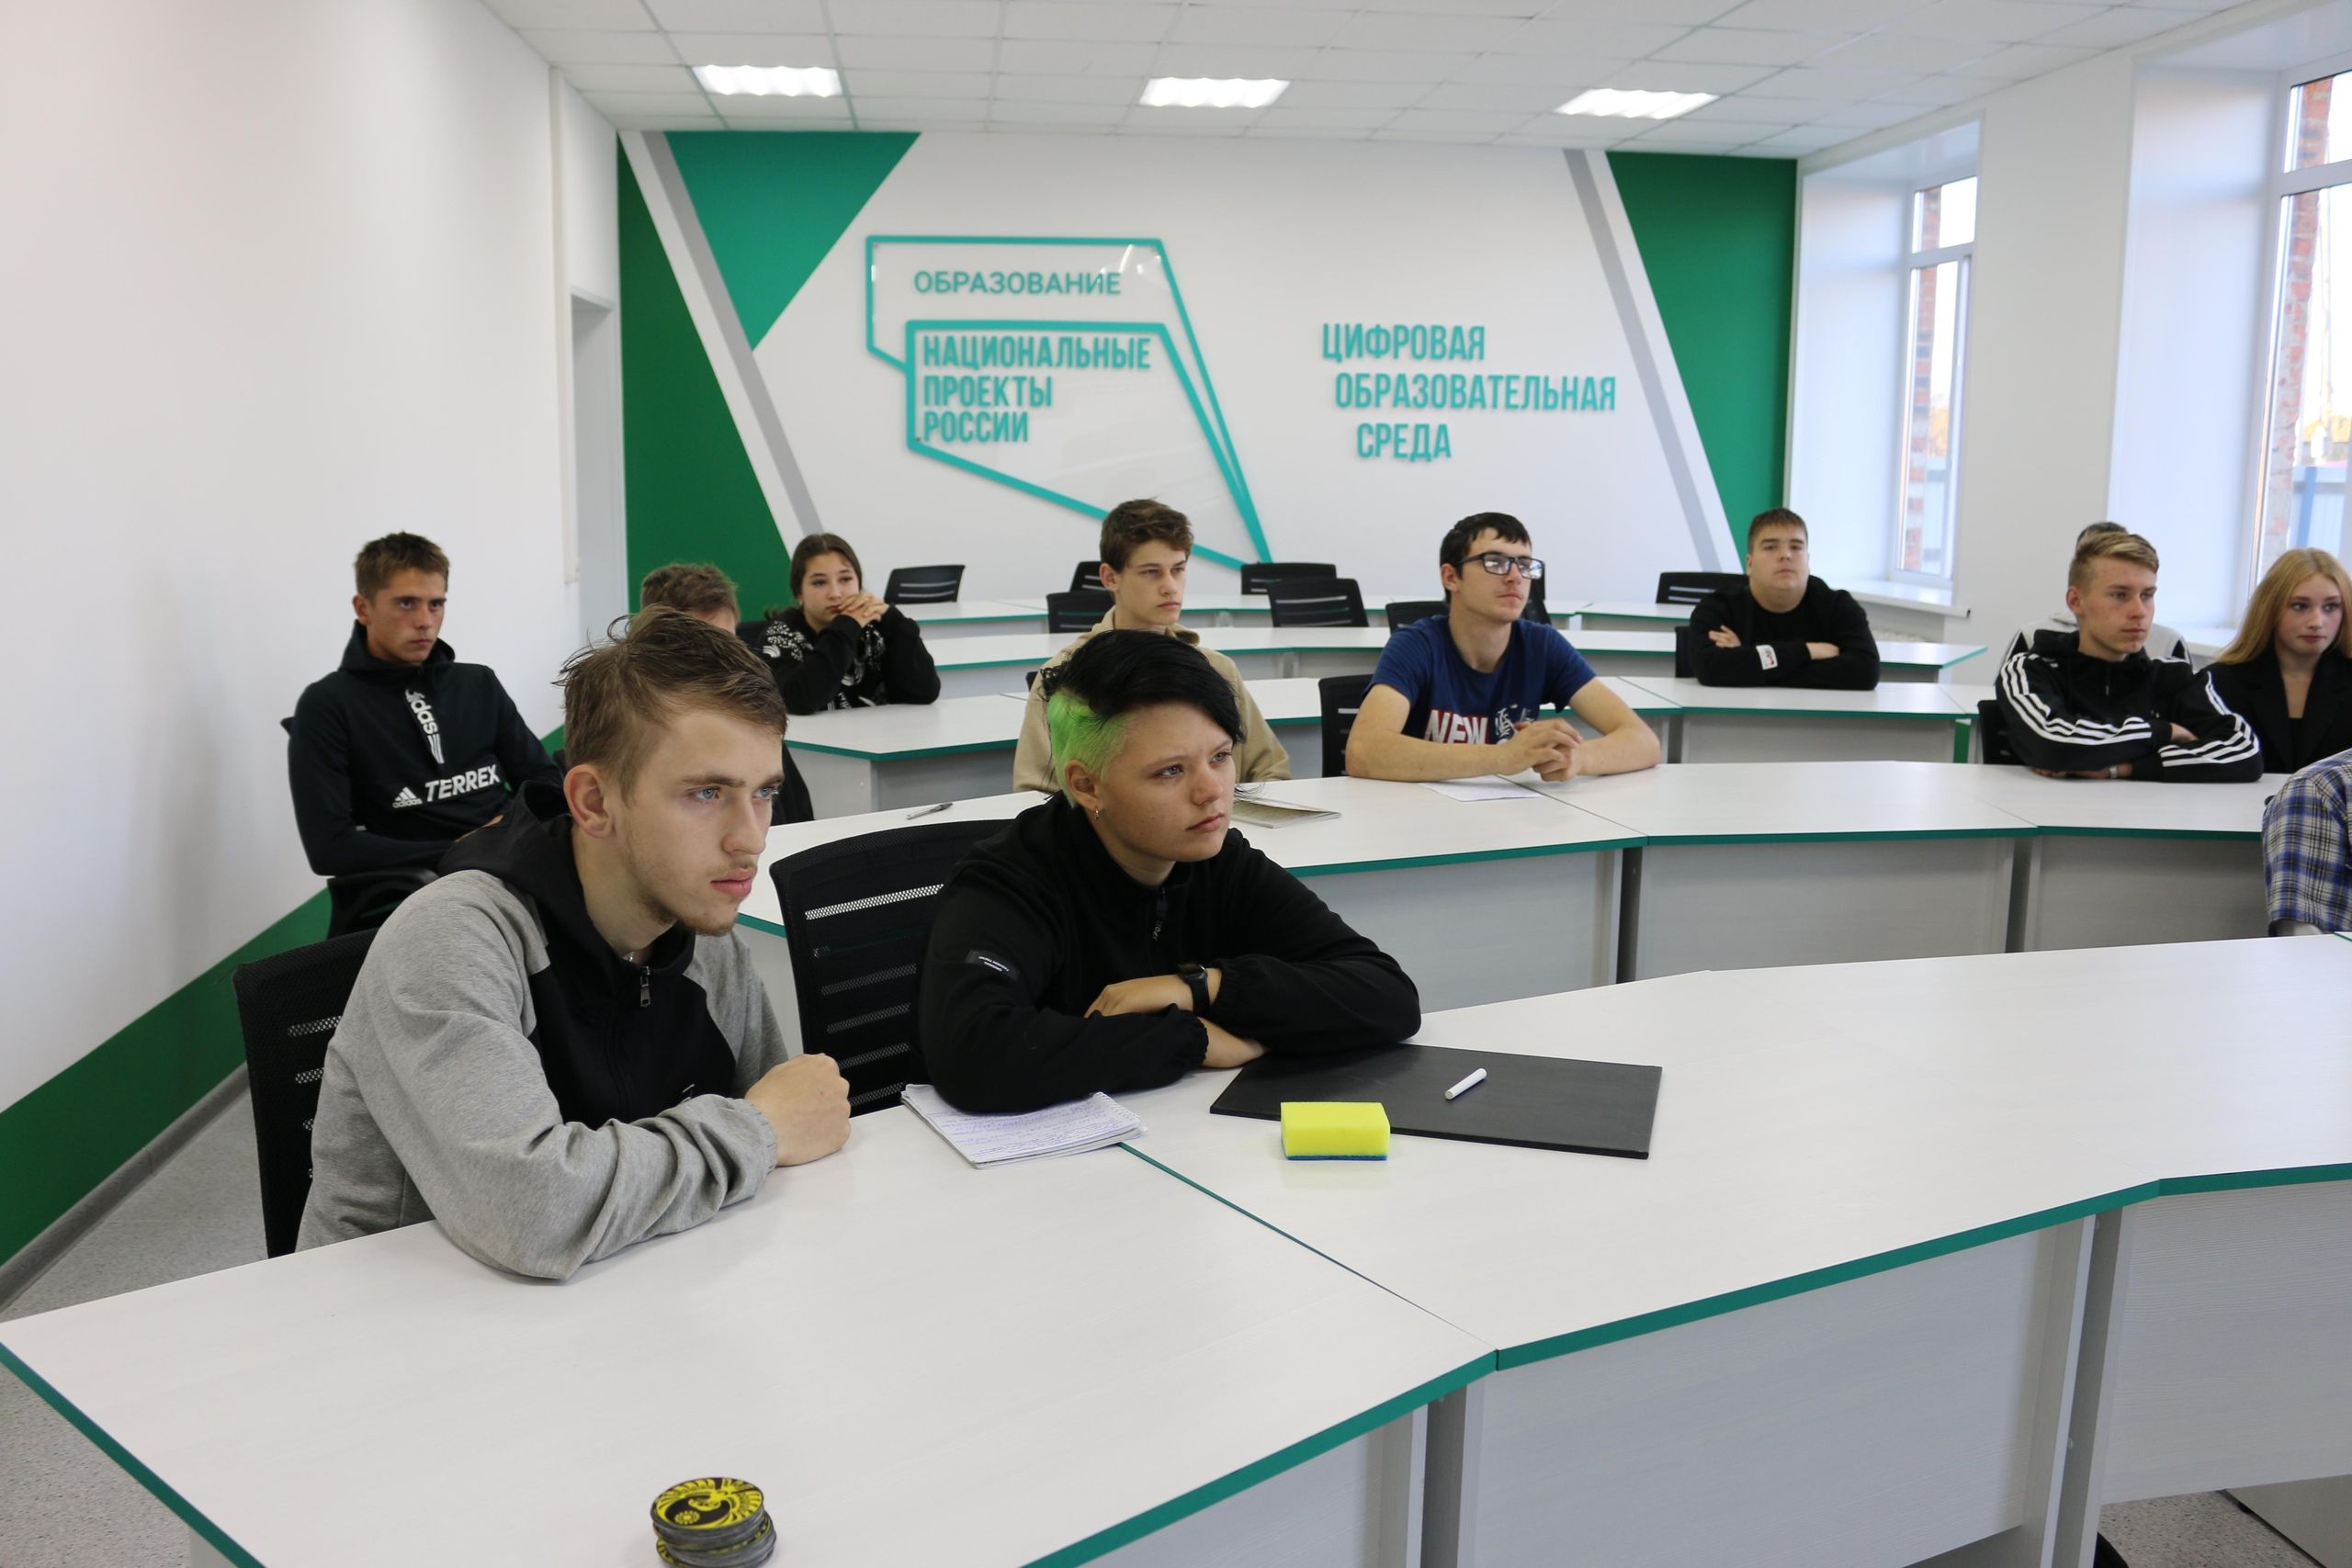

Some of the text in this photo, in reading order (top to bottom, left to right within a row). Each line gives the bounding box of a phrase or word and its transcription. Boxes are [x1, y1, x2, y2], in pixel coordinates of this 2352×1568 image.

[913, 271, 1122, 295] ОБРАЗОВАНИЕ
[923, 335, 1151, 370] НАЦИОНАЛЬНЫЕ
[1322, 322, 1486, 363] ЦИФРОВАЯ
[923, 375, 1053, 408] ПРОЕКТЫ
[1335, 372, 1617, 412] ОБРАЗОВАТЕЛЬНАЯ
[923, 411, 1029, 442] РОССИИ
[1356, 422, 1452, 462] СРЕДА
[1424, 709, 1488, 744] NEW
[392, 764, 501, 808] adidas TERREX
